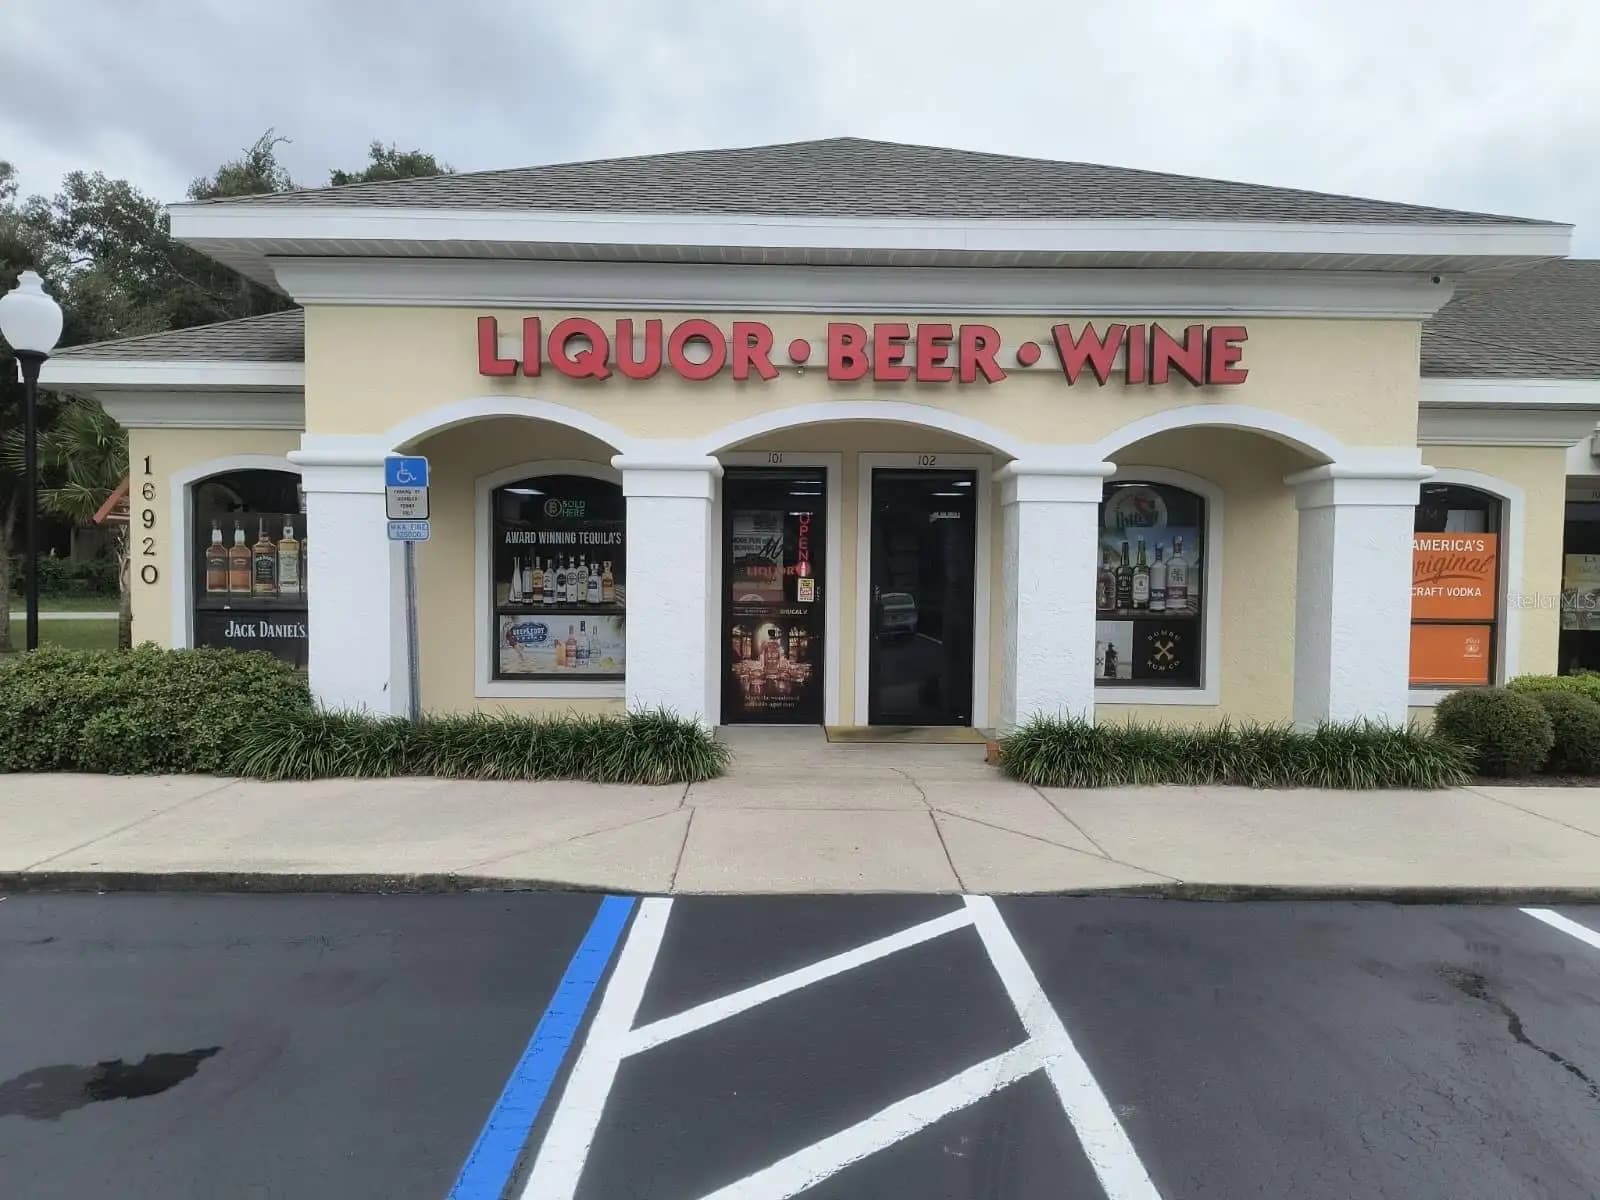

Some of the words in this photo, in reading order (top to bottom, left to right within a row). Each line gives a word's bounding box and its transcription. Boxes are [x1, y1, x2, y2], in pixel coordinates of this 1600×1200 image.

[477, 316, 780, 382] LIQUOR
[827, 322, 1007, 384] BEER
[1050, 321, 1250, 386] WINE
[768, 453, 783, 463] 101
[918, 455, 936, 466] 102
[141, 455, 159, 584] 16920
[505, 531, 537, 544] AWARD
[539, 531, 577, 544] WINNING
[579, 532, 622, 545] TEQUILA'S
[799, 512, 811, 562] OPEN
[1411, 539, 1485, 551] AMERICA'S
[1414, 553, 1495, 584] riginal
[1446, 587, 1482, 597] VODKA
